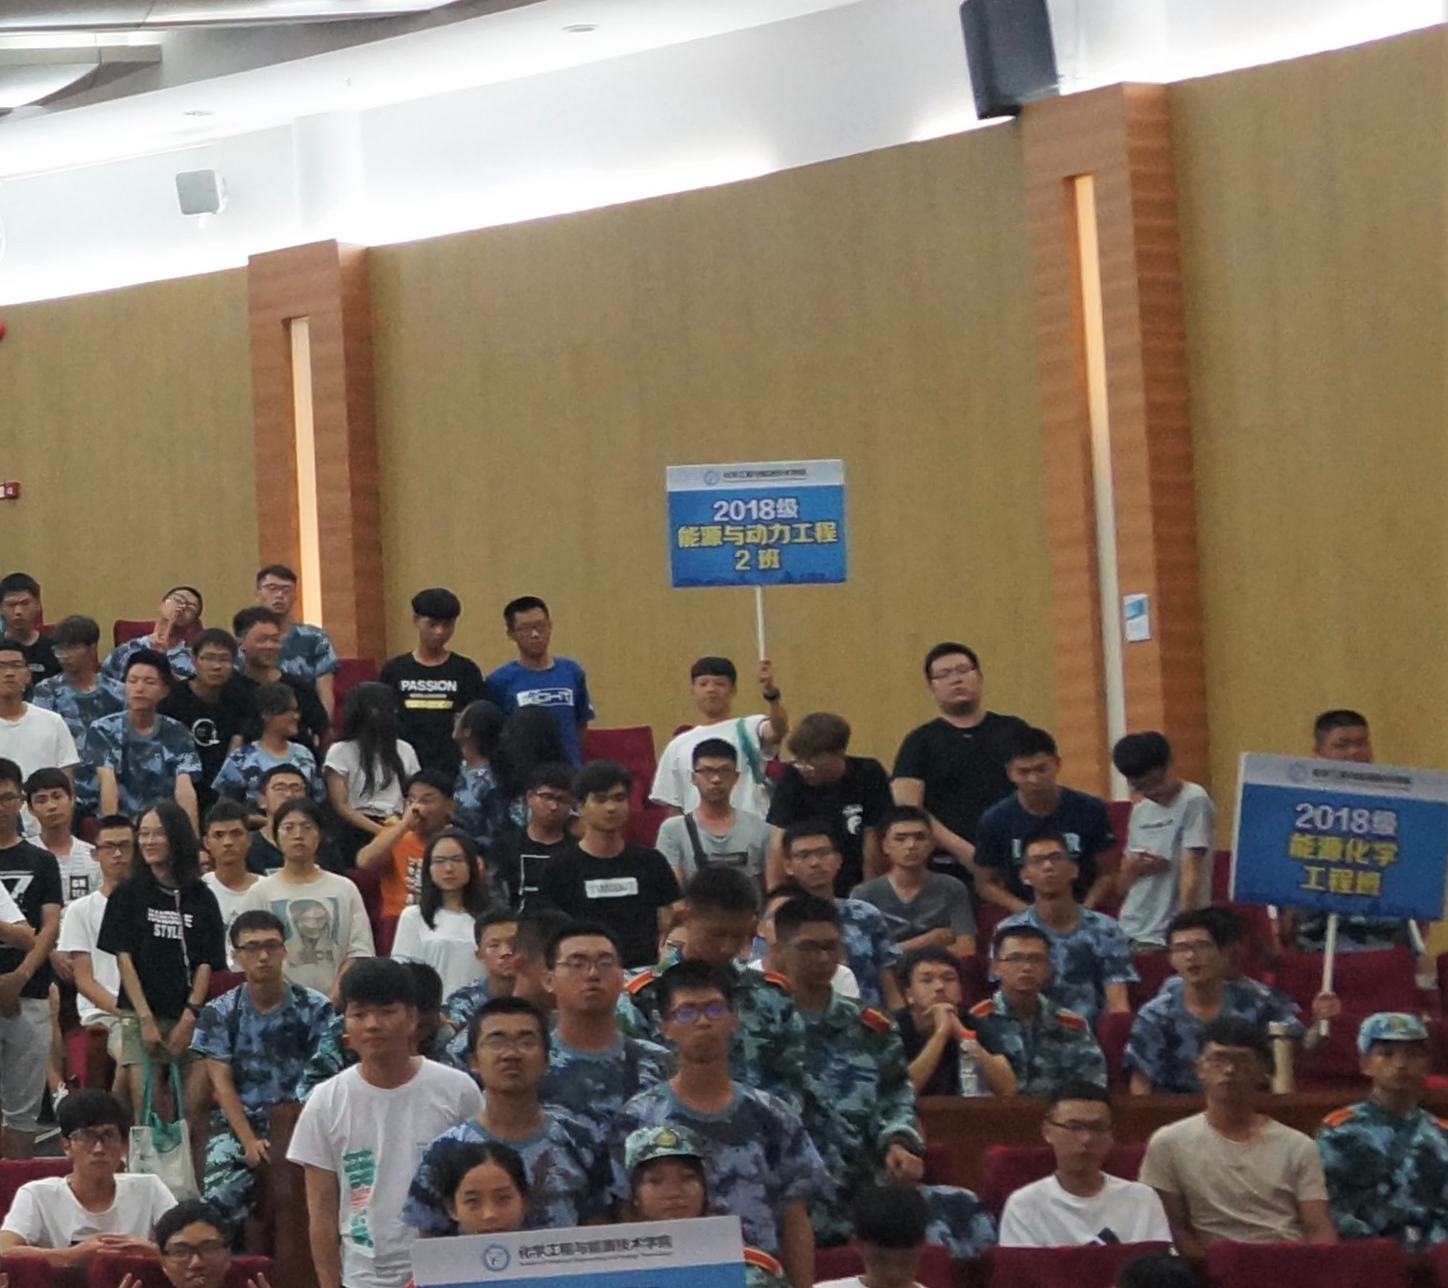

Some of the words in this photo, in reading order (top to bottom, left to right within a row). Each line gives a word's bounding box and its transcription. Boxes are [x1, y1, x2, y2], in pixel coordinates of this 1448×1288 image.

[713, 498, 798, 521] 2018级
[678, 522, 838, 548] 能源与动力工程
[401, 680, 457, 692] PASSION
[1295, 802, 1398, 836] 2018级
